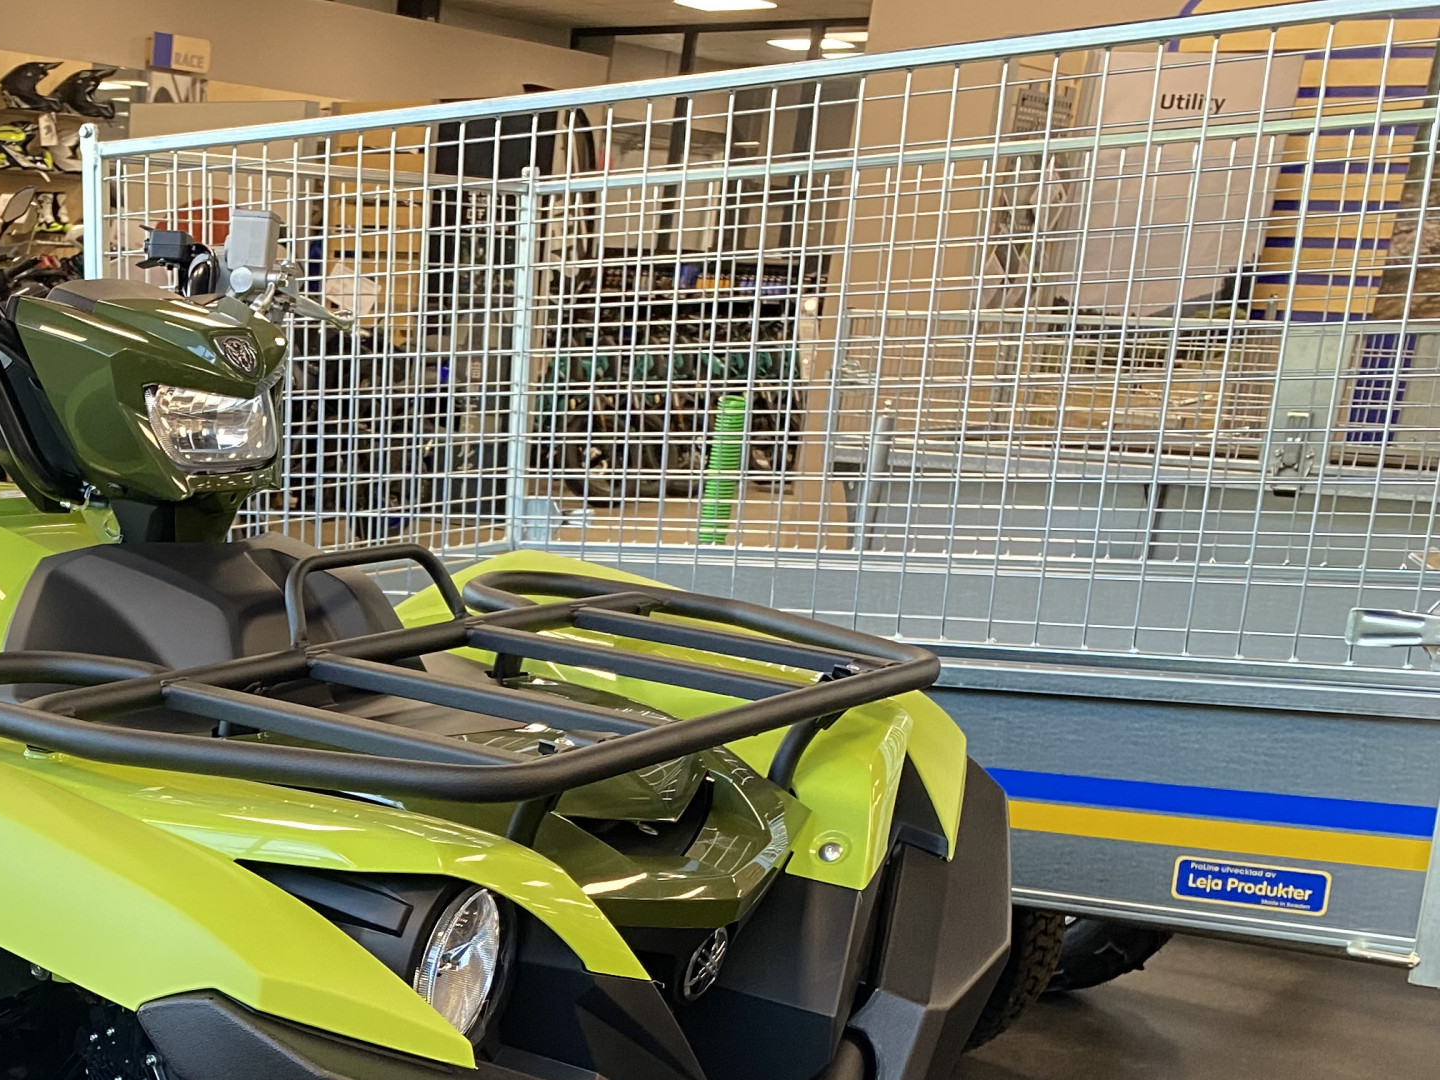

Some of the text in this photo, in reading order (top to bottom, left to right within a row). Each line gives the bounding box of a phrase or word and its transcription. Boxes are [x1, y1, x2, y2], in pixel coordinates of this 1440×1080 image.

[1221, 866, 1264, 877] utvecklad
[1264, 870, 1277, 879] av
[1188, 873, 1313, 901] Leja Produkter
